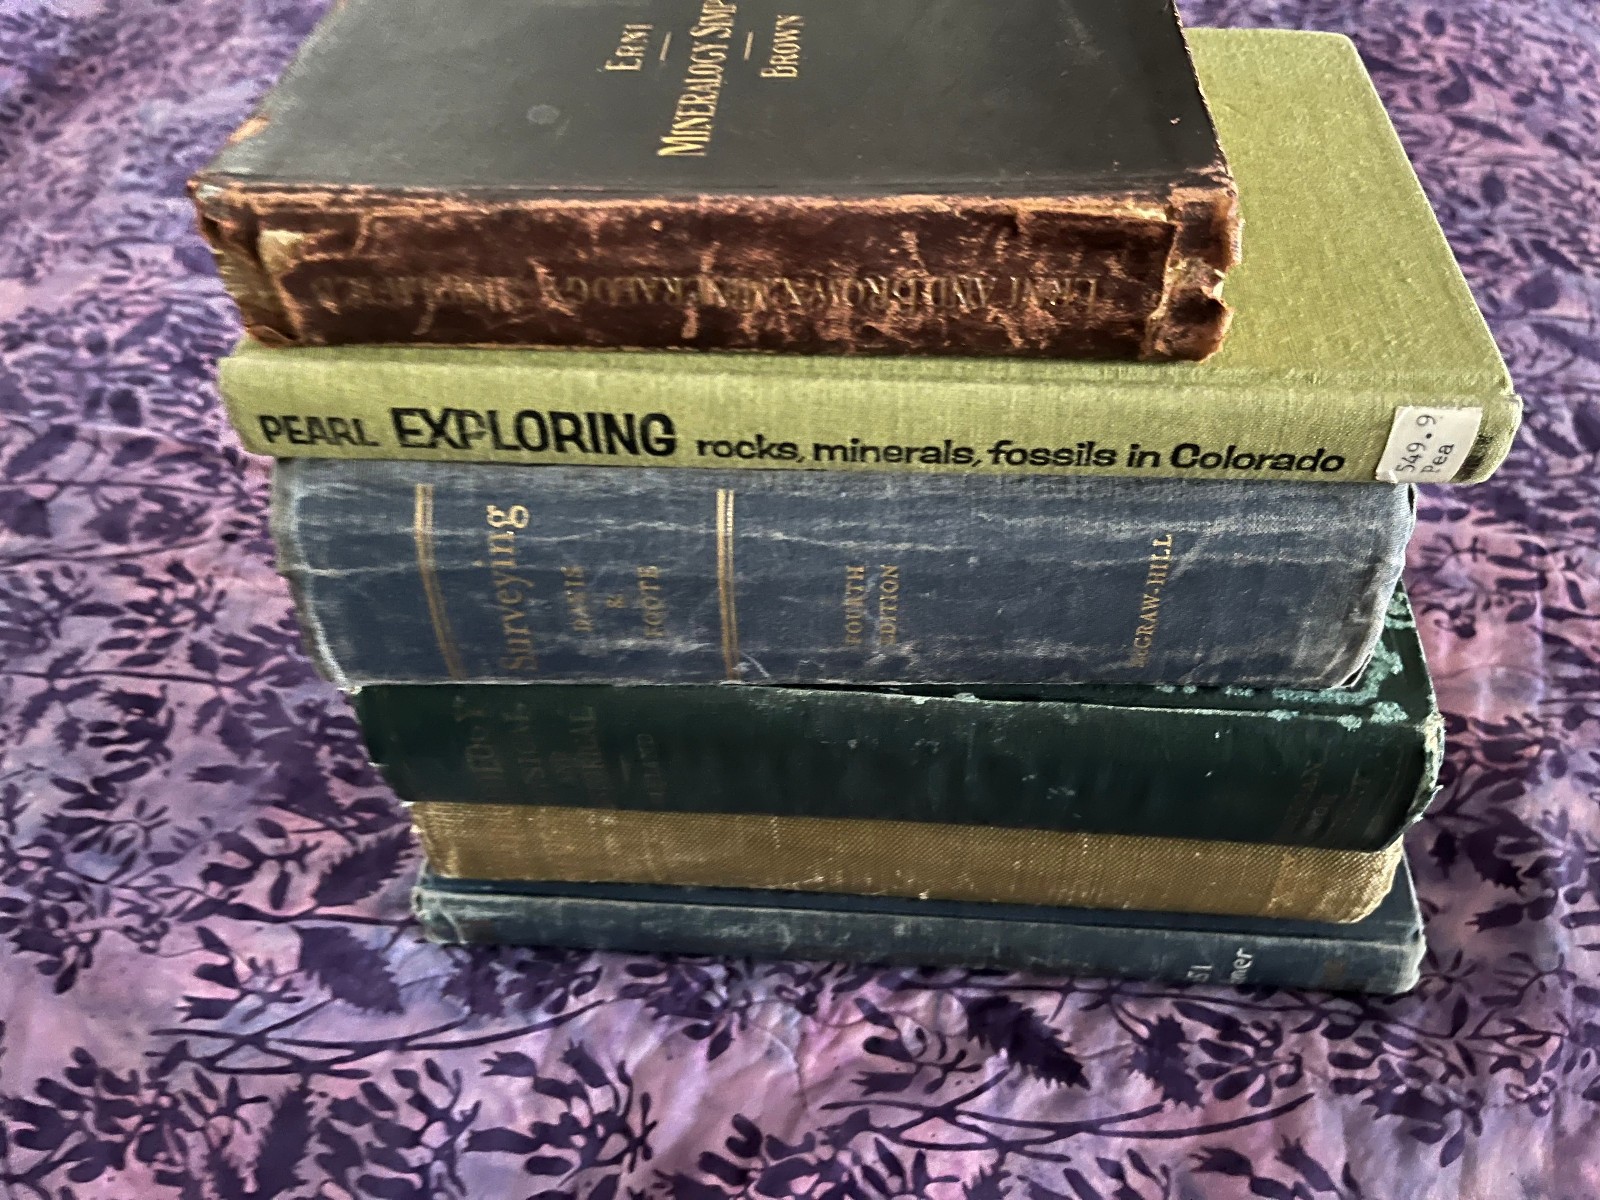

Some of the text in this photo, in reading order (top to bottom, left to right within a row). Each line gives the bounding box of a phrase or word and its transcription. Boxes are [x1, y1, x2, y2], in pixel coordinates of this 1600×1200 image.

[605, 24, 653, 71] ERNI
[760, 14, 804, 78] BROWN
[657, 42, 729, 156] MINERALOGY
[258, 406, 1346, 473] PEARL EXPLORING rocks, minerals, fossils in Colorado
[1395, 414, 1436, 473] 549.9
[1420, 444, 1454, 473] Pea
[471, 504, 538, 672] Surveying
[843, 564, 865, 645] FOURTH
[879, 563, 900, 645] EDITION
